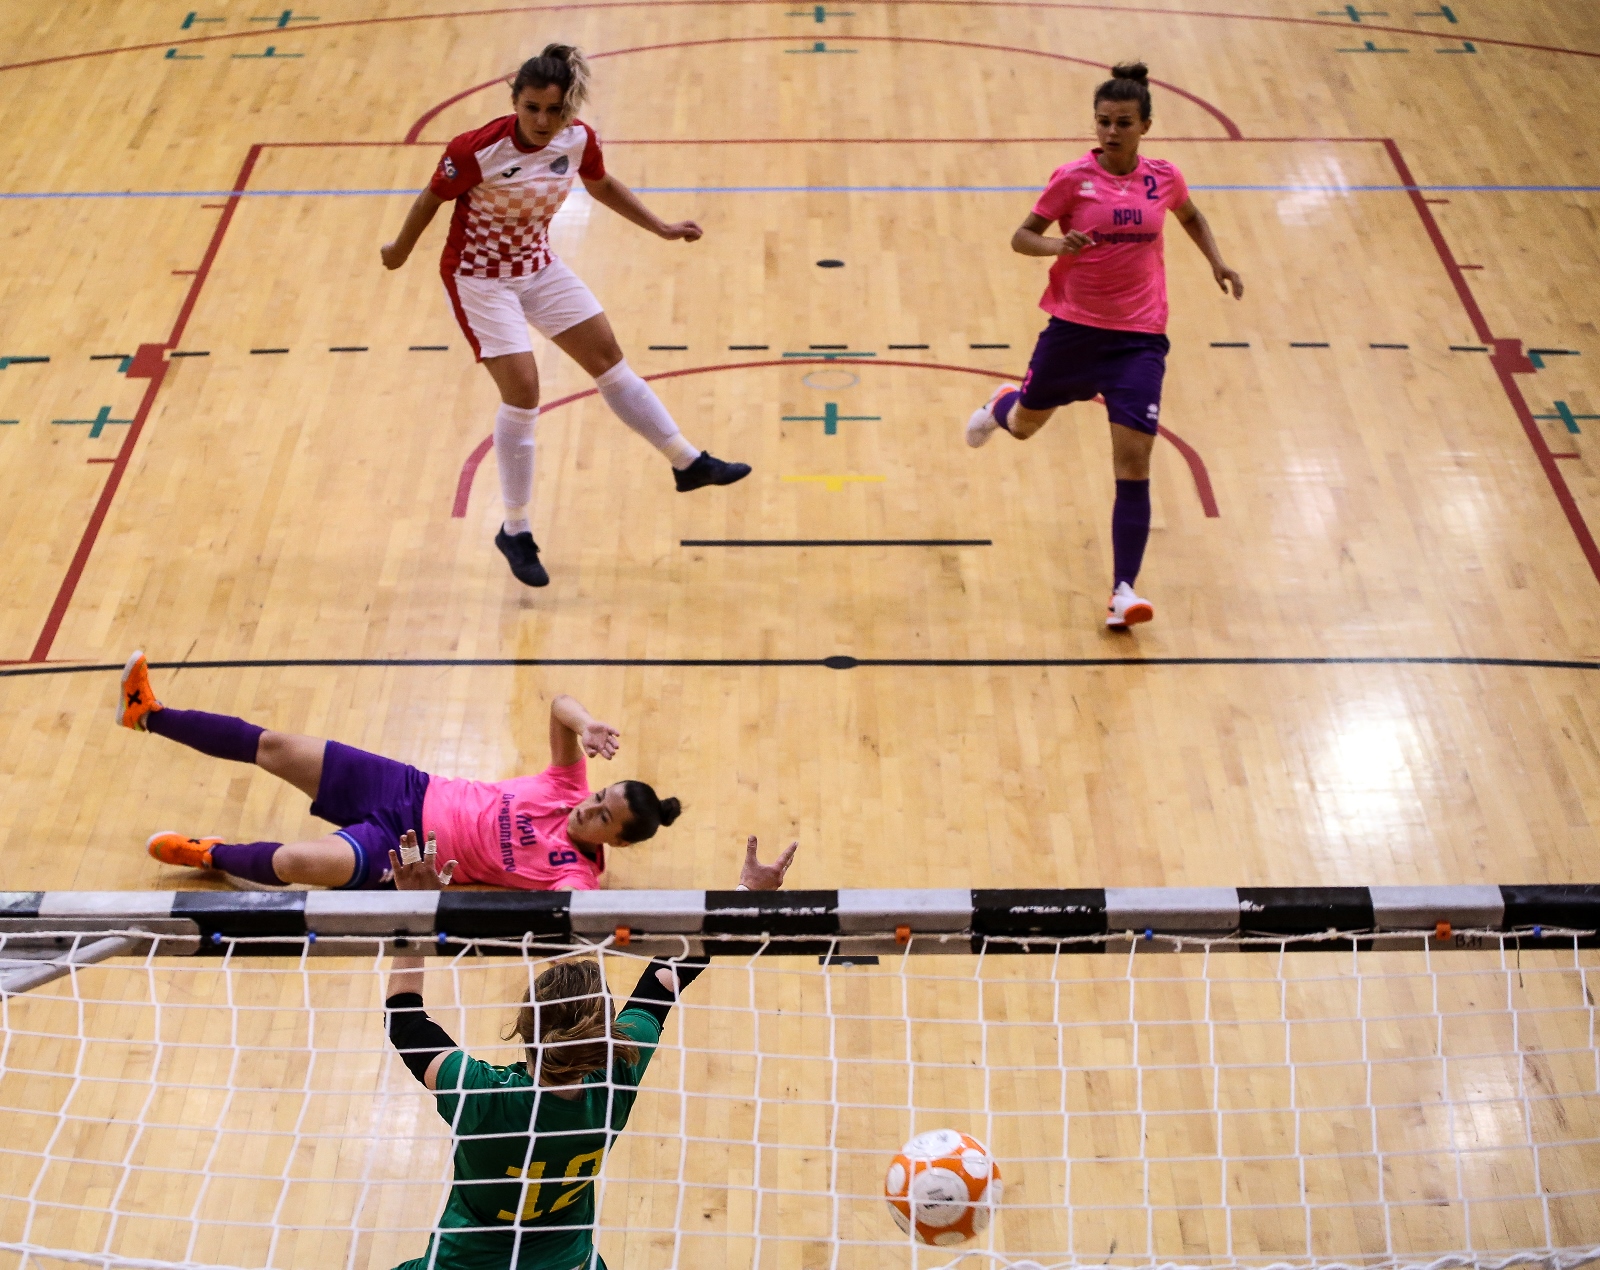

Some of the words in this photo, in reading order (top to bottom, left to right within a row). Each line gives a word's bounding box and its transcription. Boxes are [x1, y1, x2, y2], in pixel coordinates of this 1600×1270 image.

[1143, 175, 1159, 200] 2
[1112, 208, 1143, 226] NPU
[498, 793, 517, 872] Dragomanov
[515, 814, 537, 847] NPU
[548, 850, 578, 867] 9
[496, 1146, 606, 1221] 12
